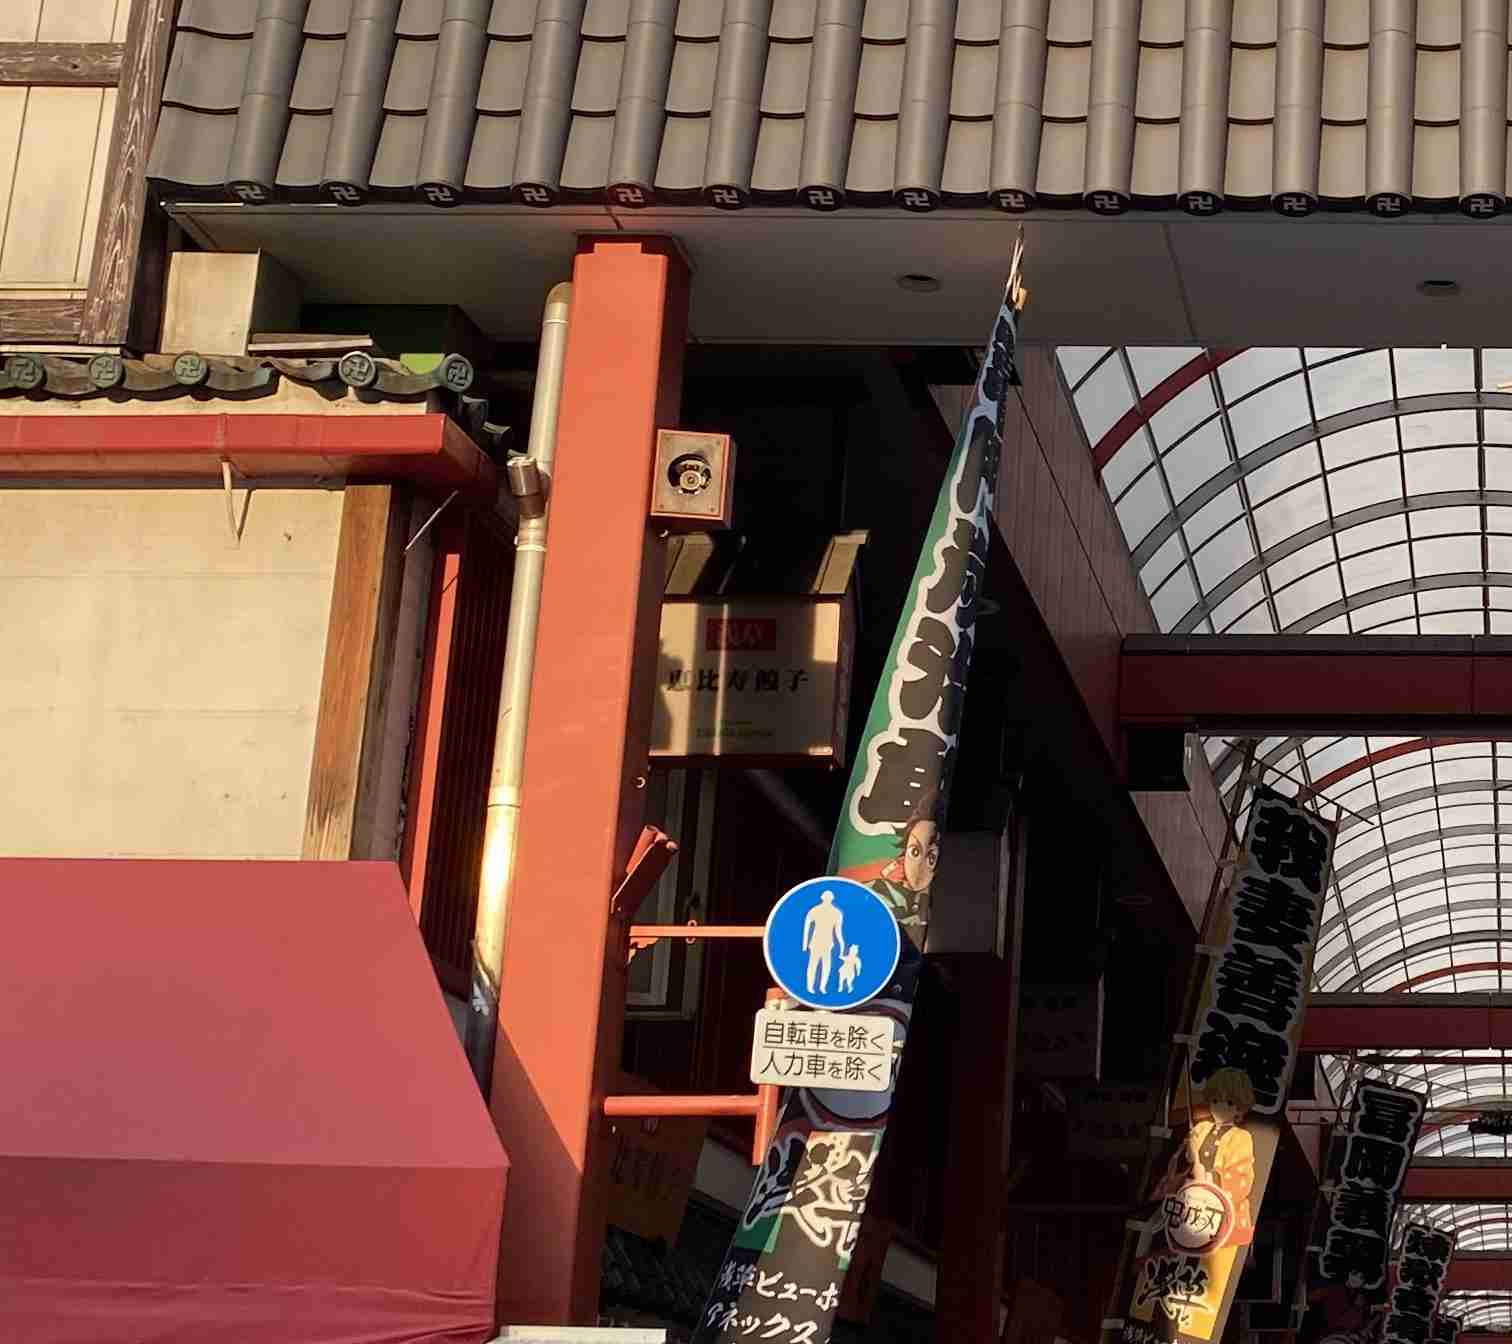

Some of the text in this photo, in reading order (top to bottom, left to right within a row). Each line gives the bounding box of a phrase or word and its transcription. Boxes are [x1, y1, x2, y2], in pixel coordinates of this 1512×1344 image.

[765, 1020, 885, 1050] 自転車を除く
[760, 1050, 882, 1080] 人力車を除く
